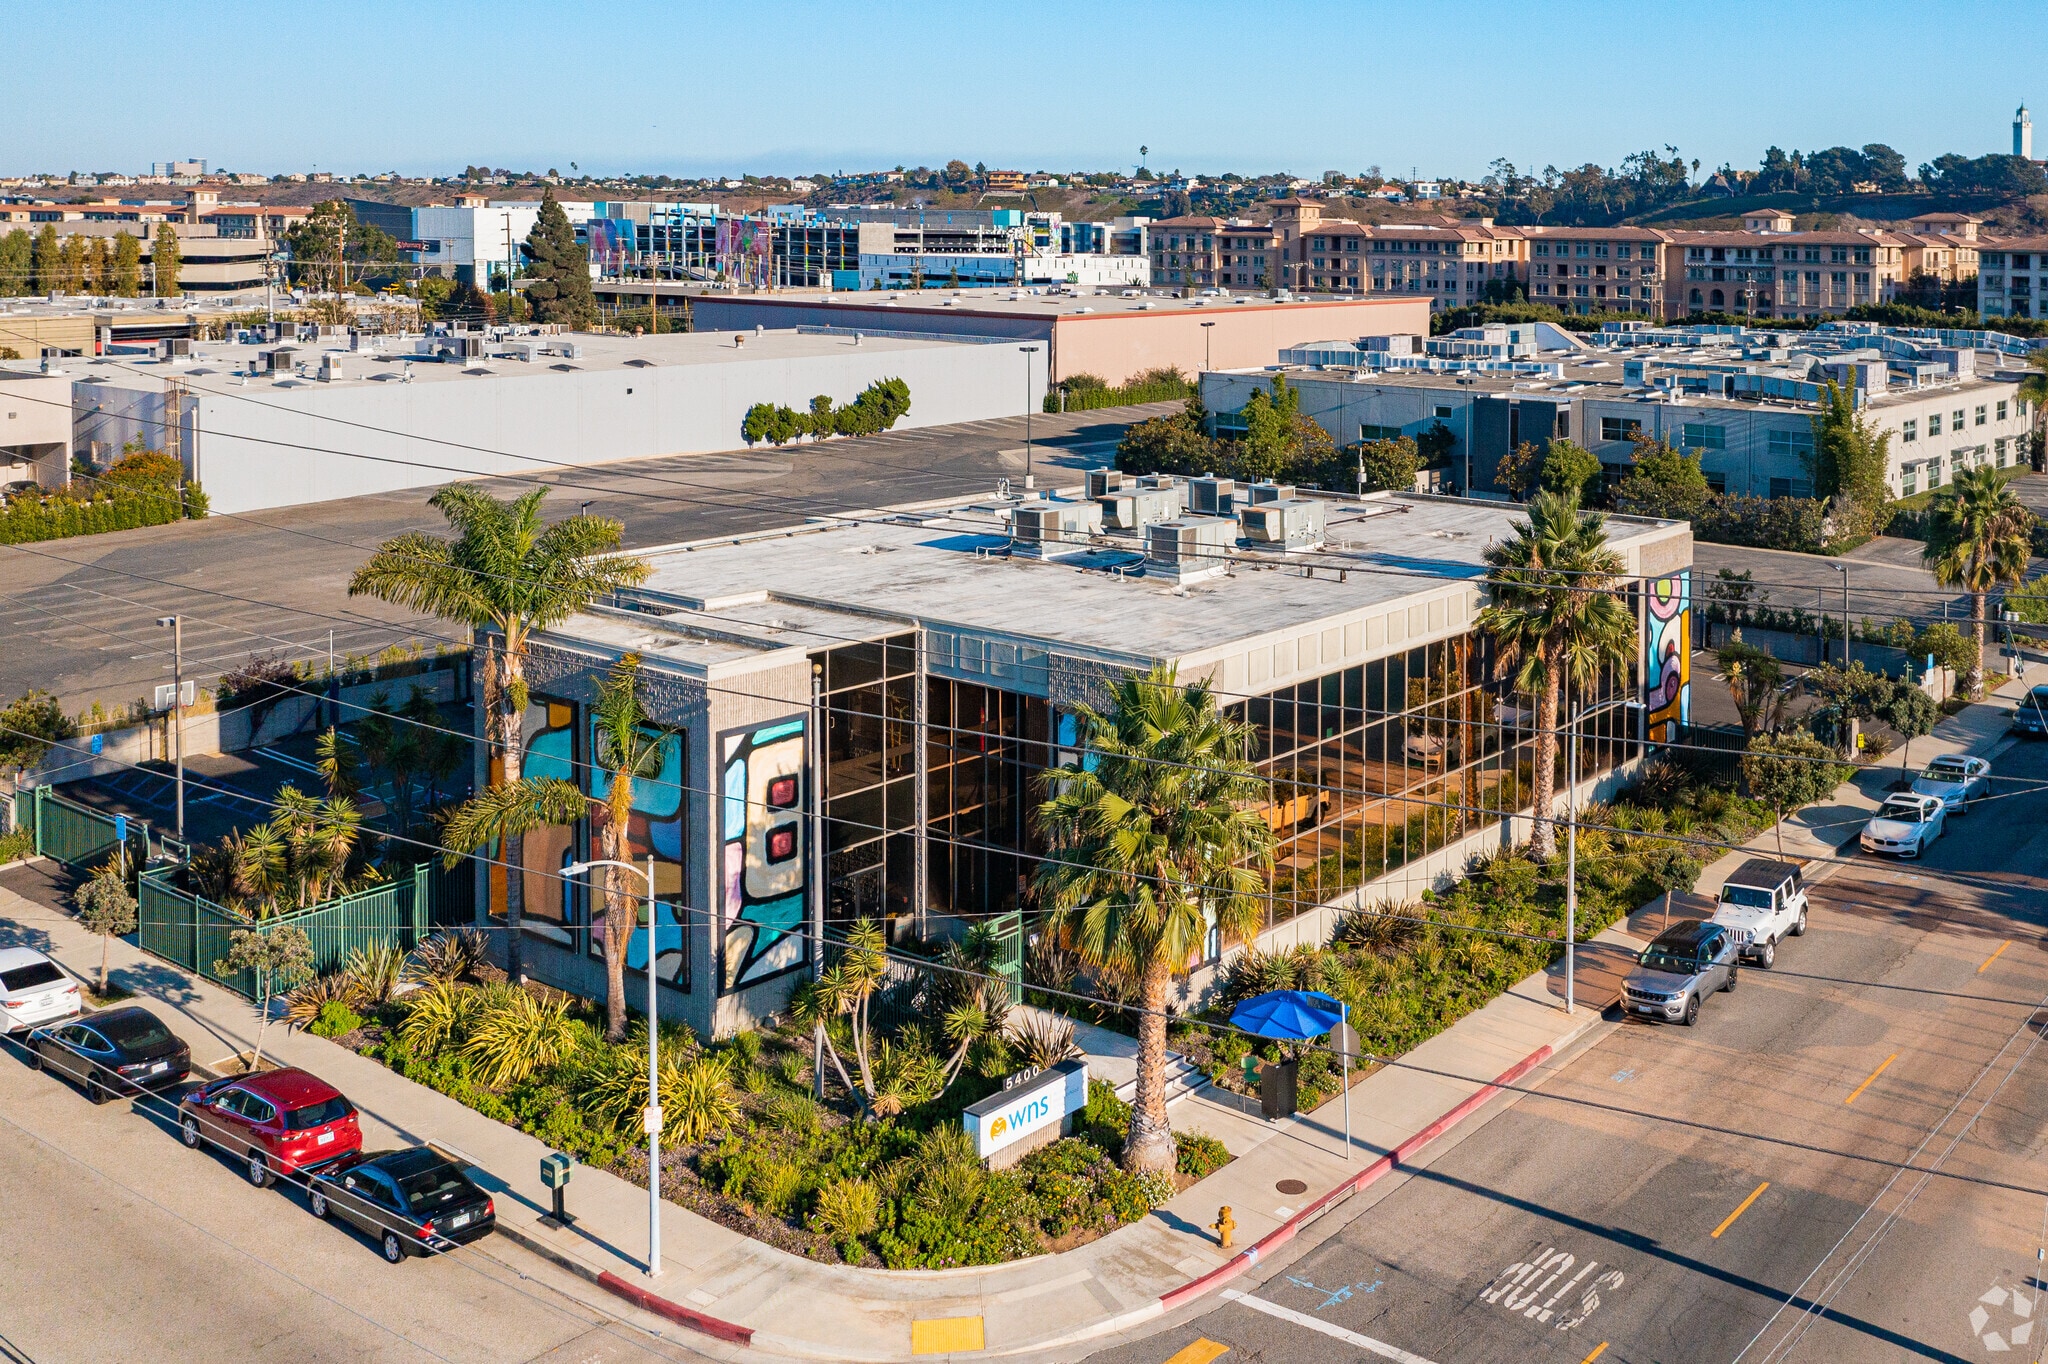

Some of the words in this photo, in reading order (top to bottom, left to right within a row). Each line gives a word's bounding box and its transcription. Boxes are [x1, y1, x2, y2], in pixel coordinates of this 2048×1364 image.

[1006, 1065, 1040, 1090] 5400
[1008, 1096, 1049, 1131] wns
[1479, 1247, 1625, 1331] STOP
